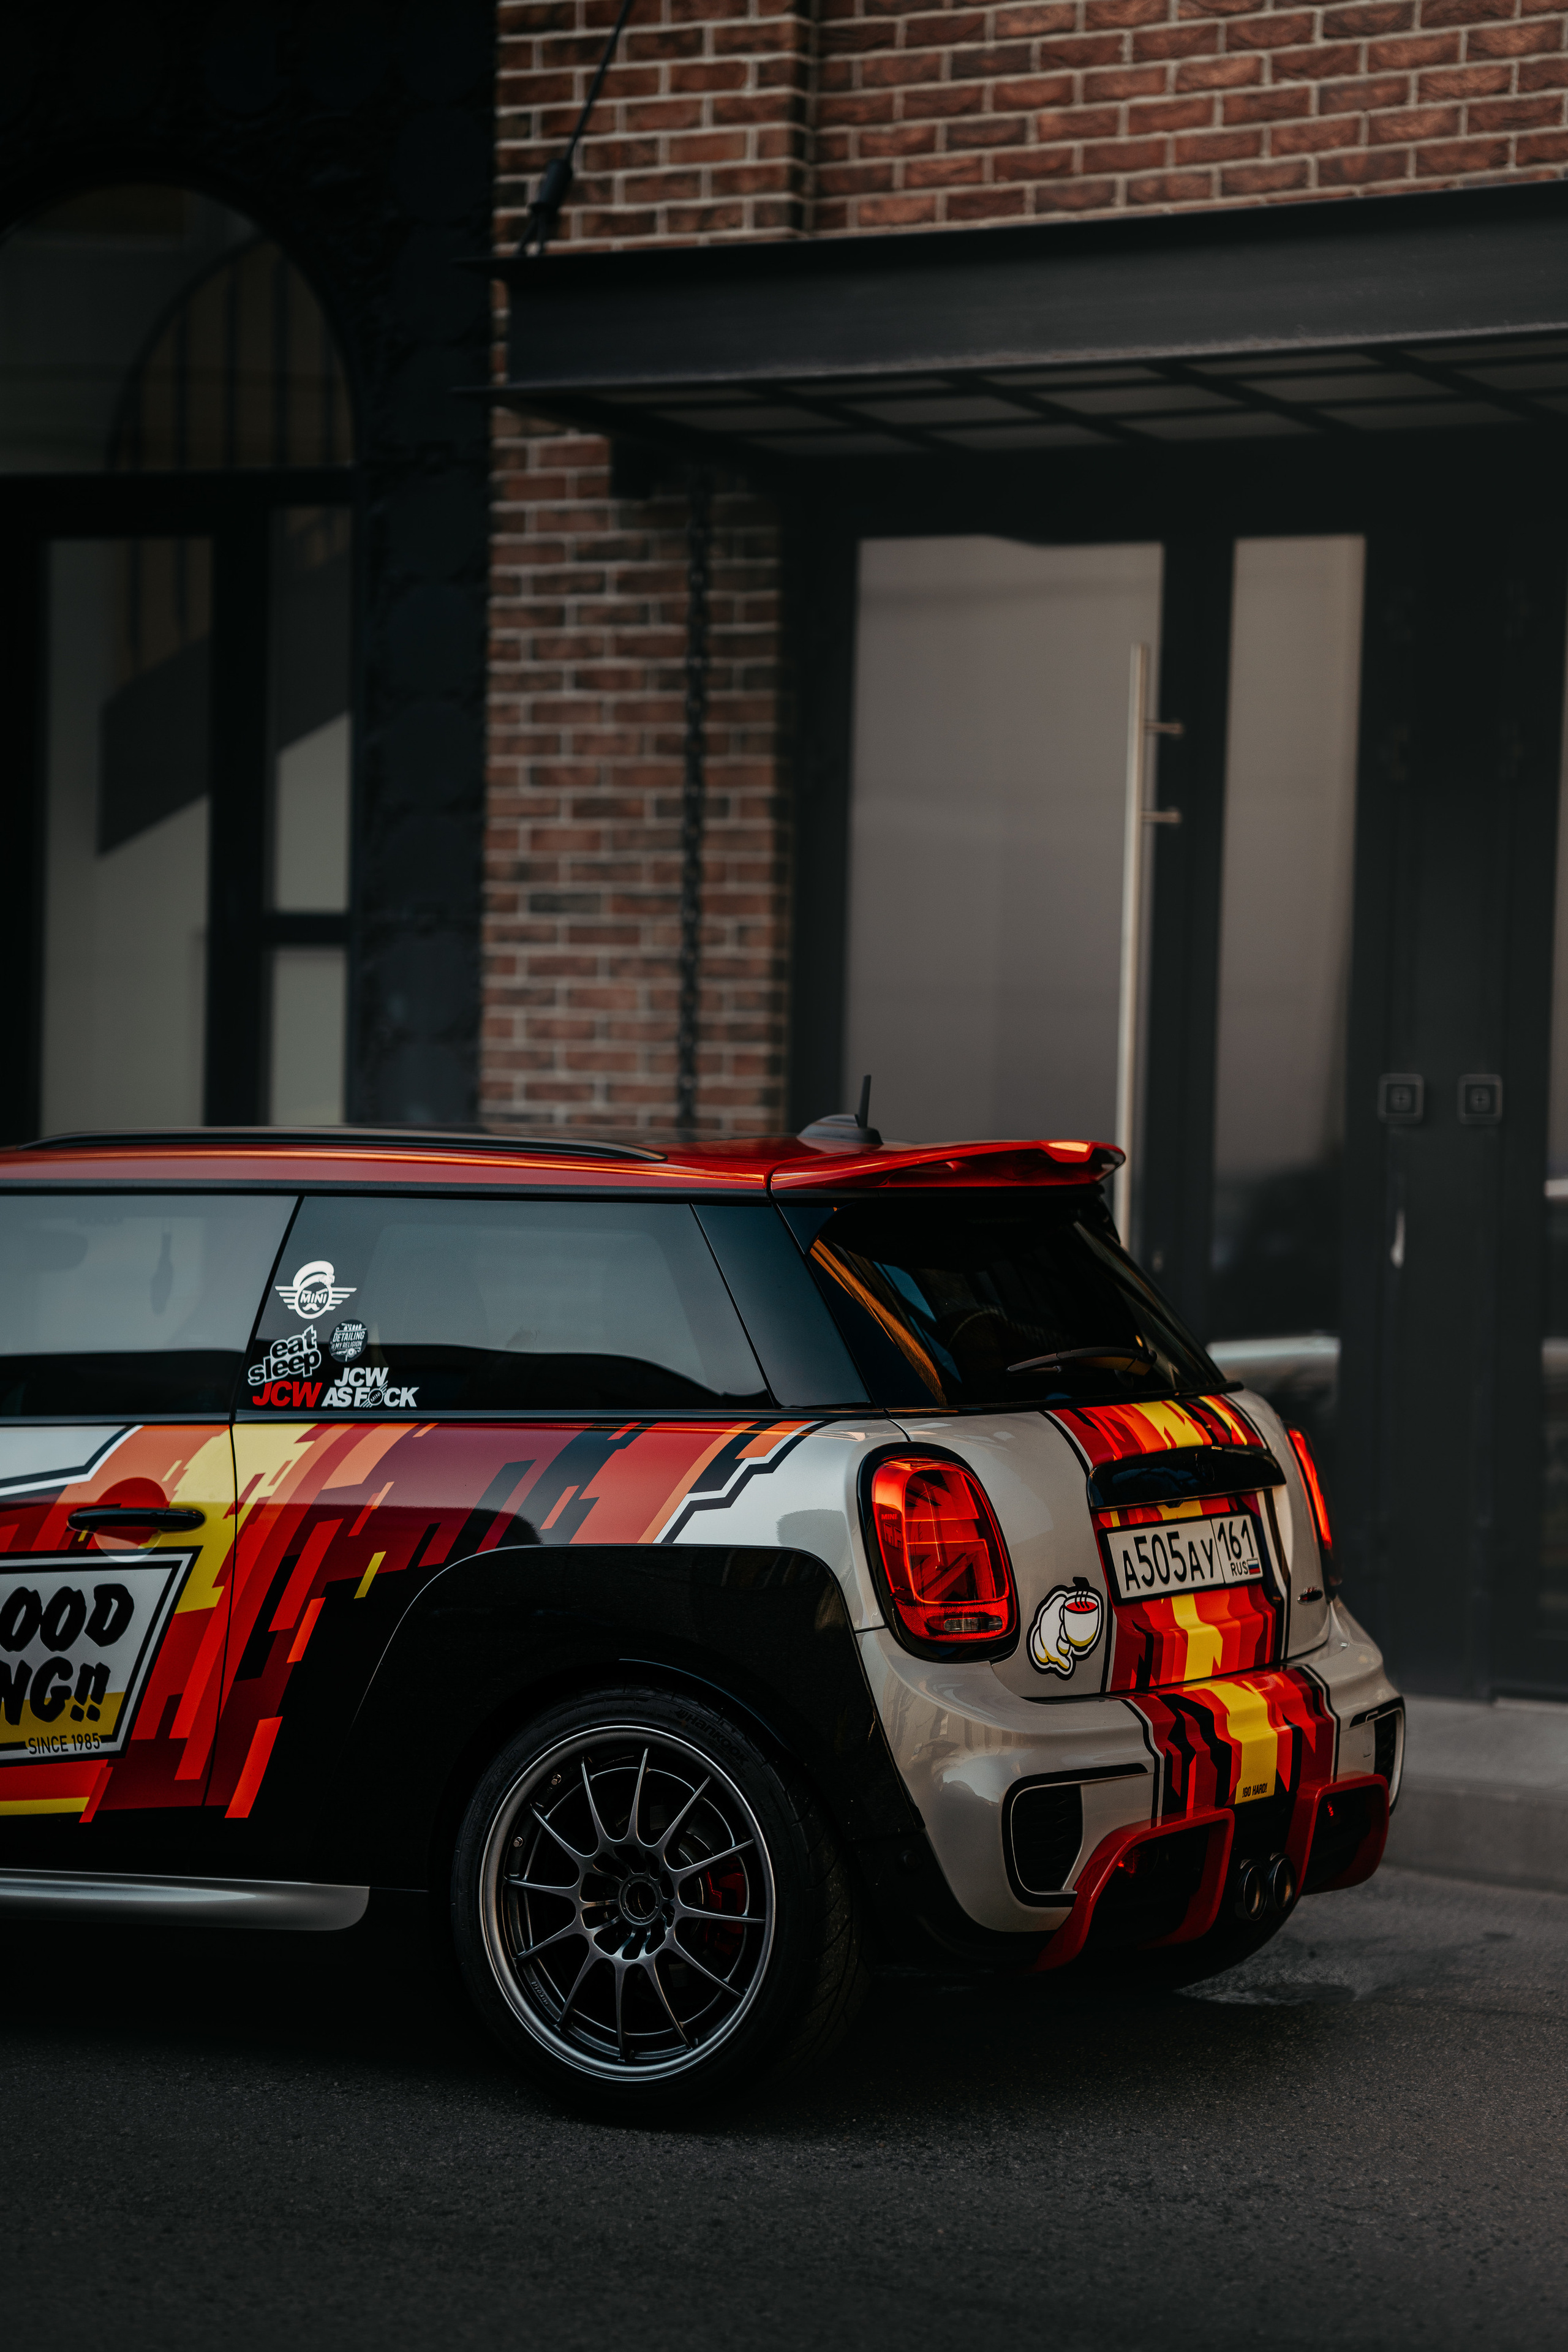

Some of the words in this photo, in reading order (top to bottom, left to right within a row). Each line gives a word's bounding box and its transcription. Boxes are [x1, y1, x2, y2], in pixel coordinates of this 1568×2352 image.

[300, 1292, 328, 1303] MINI
[270, 1324, 318, 1360] eat
[333, 1330, 365, 1343] DETAILING
[342, 1340, 363, 1349] RELIGION
[247, 1349, 322, 1386] sleep
[334, 1366, 389, 1387] JCW
[252, 1381, 323, 1408] JCW
[370, 1392, 382, 1403] MINI
[1217, 1519, 1254, 1561] 161
[1230, 1560, 1249, 1577] RUS
[28, 1735, 69, 1755] SINCE
[71, 1733, 100, 1751] 1985
